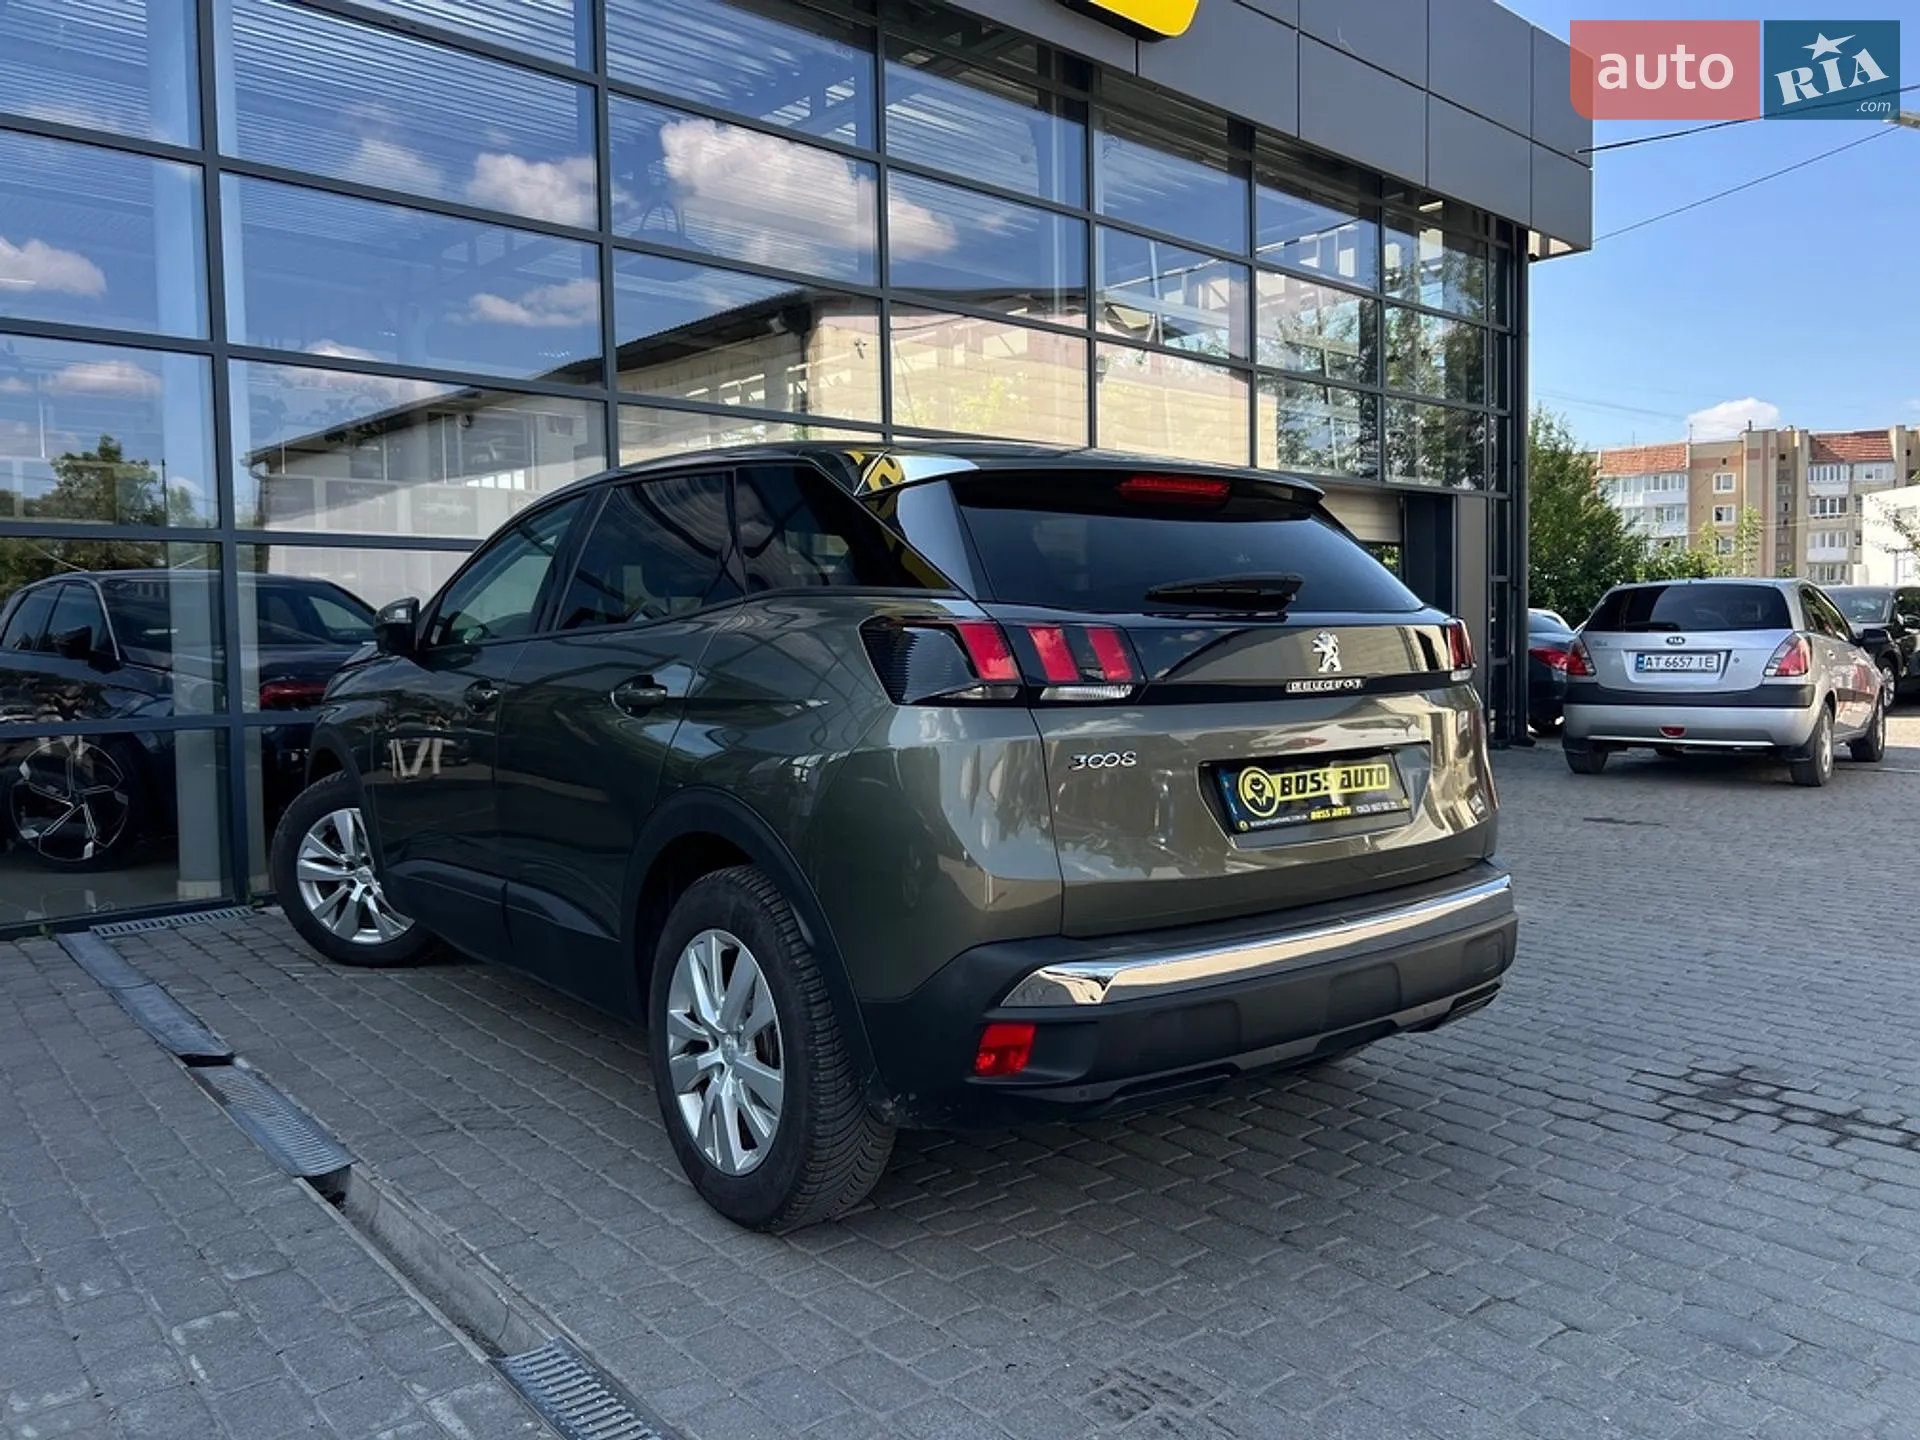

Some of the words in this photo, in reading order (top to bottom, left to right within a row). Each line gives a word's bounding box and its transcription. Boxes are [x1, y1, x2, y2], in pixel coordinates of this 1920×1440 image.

[1667, 636, 1684, 644] KIA
[1645, 656, 1662, 668] AT
[1664, 656, 1693, 668] 6657
[1698, 656, 1715, 668] IE
[1286, 679, 1364, 693] PEUGEOT
[1068, 751, 1137, 771] 3008
